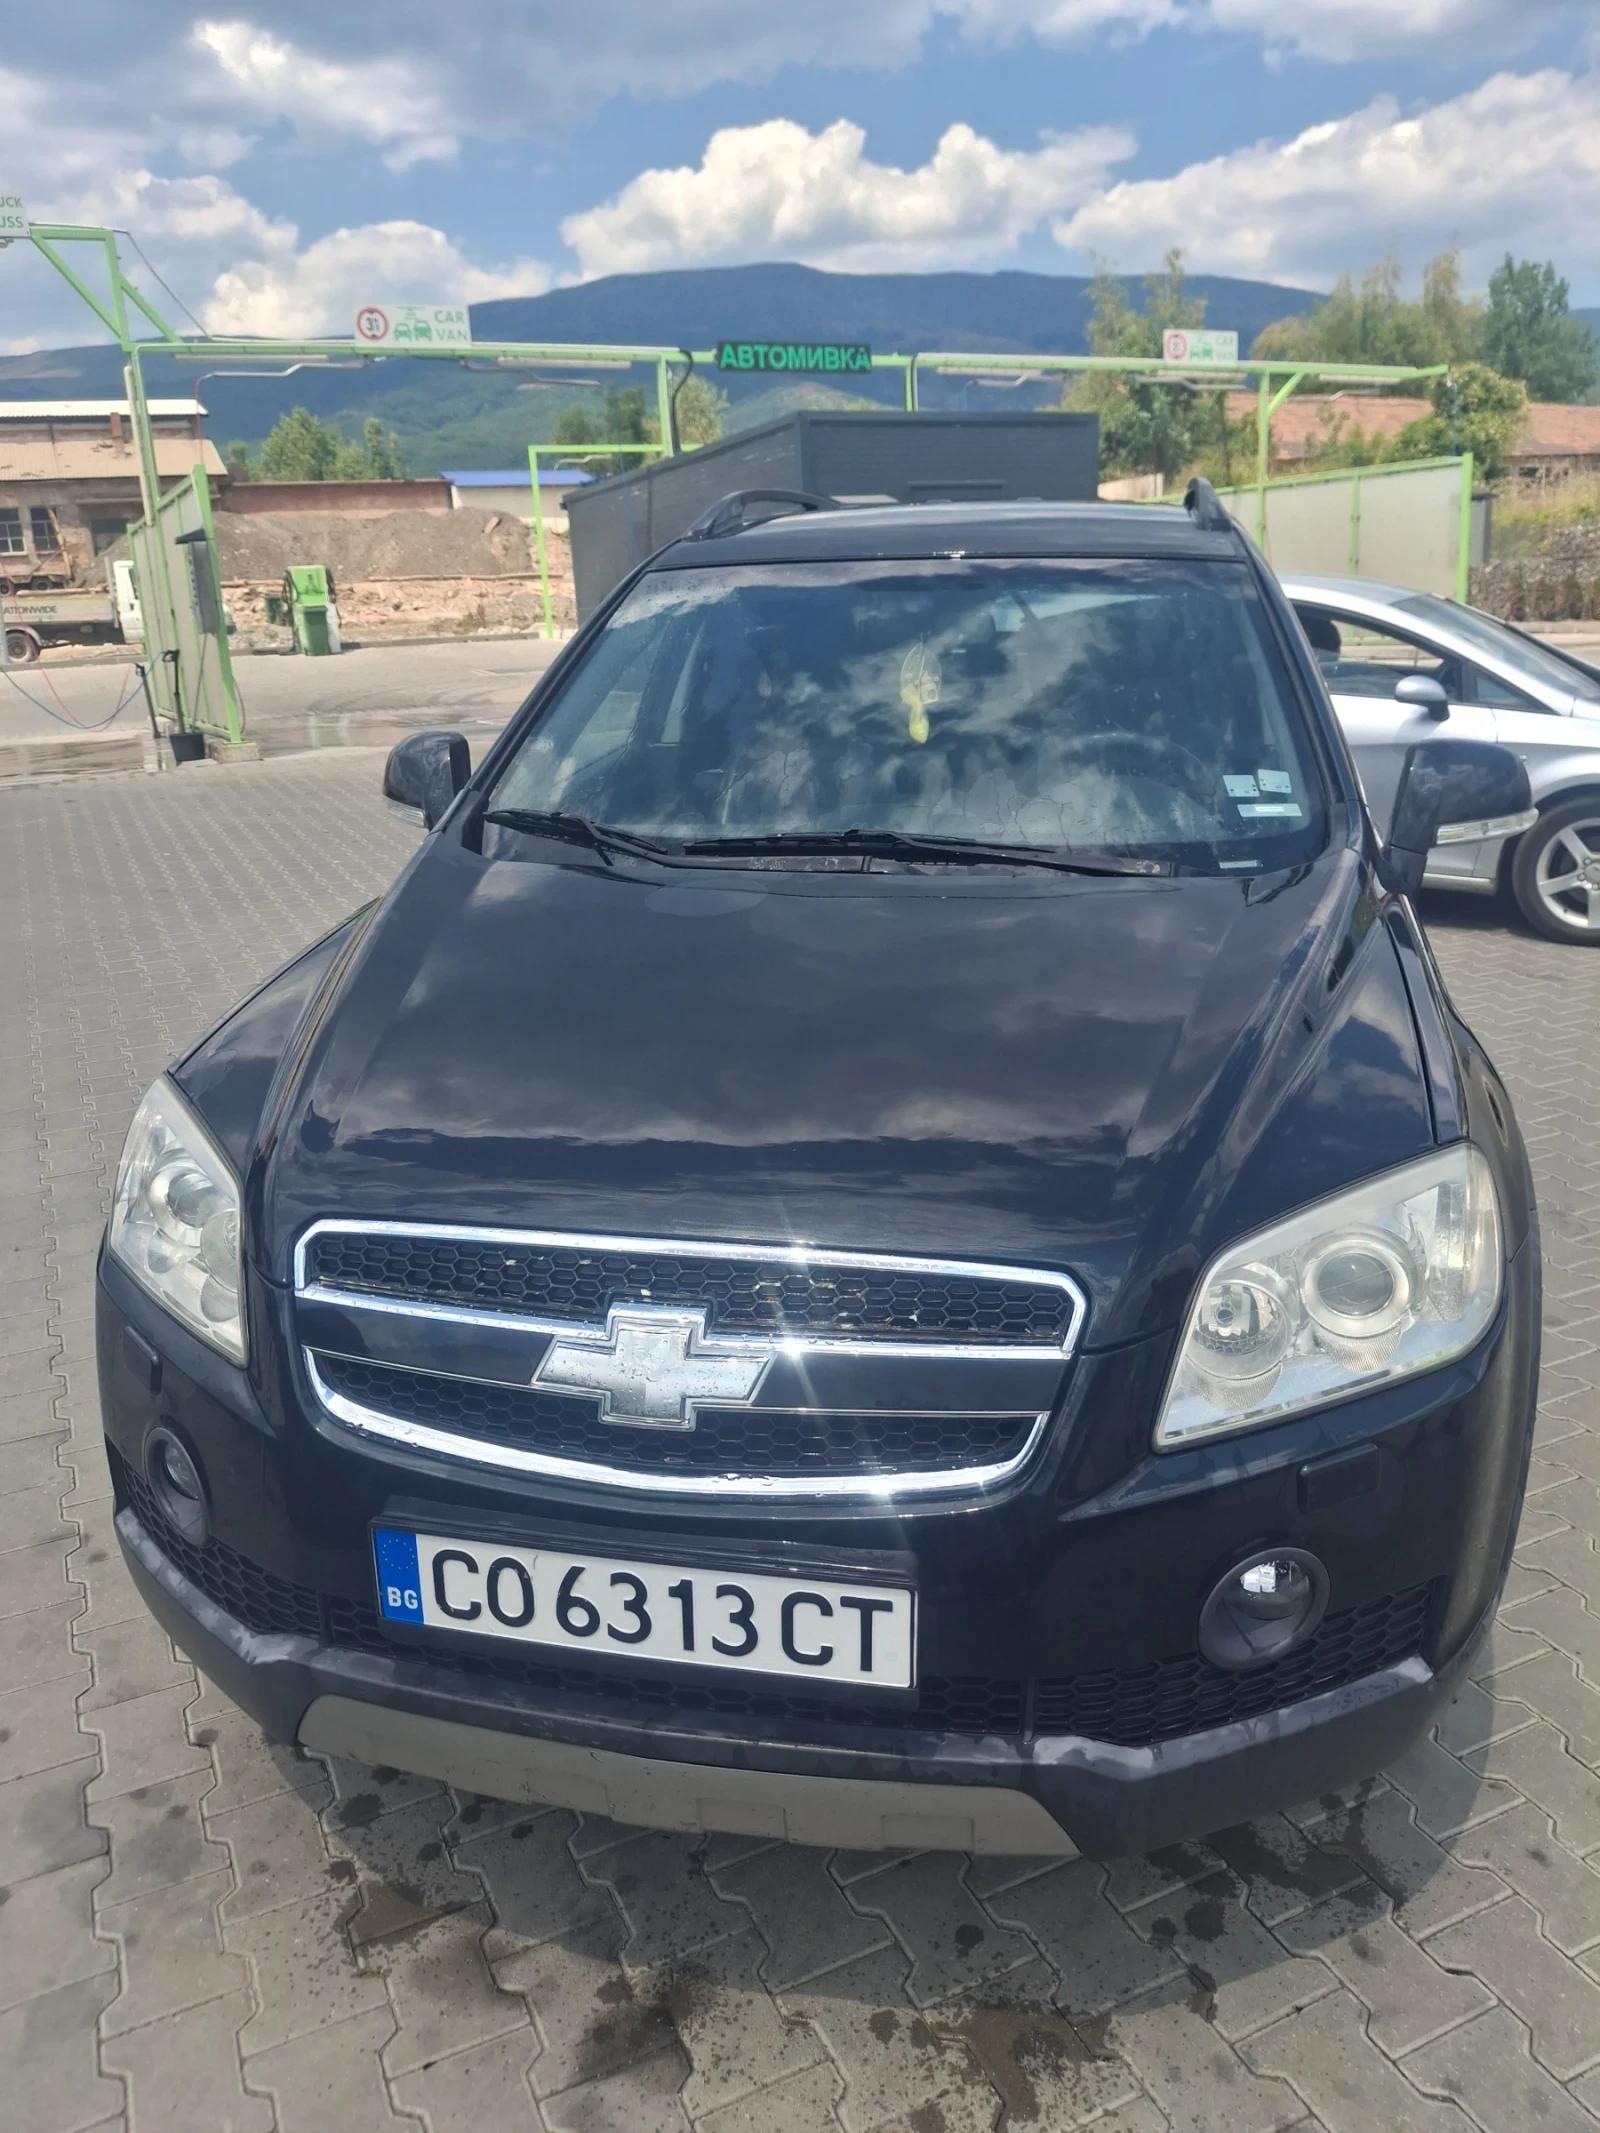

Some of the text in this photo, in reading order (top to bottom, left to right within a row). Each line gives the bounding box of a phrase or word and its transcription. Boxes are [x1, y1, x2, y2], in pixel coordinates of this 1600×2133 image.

[434, 309, 465, 324] CAR
[434, 328, 468, 341] VAN
[719, 343, 872, 371] АВТОМИВКА
[387, 1586, 418, 1609] BG
[556, 1565, 758, 1657] 6313
[781, 1591, 893, 1672] CT
